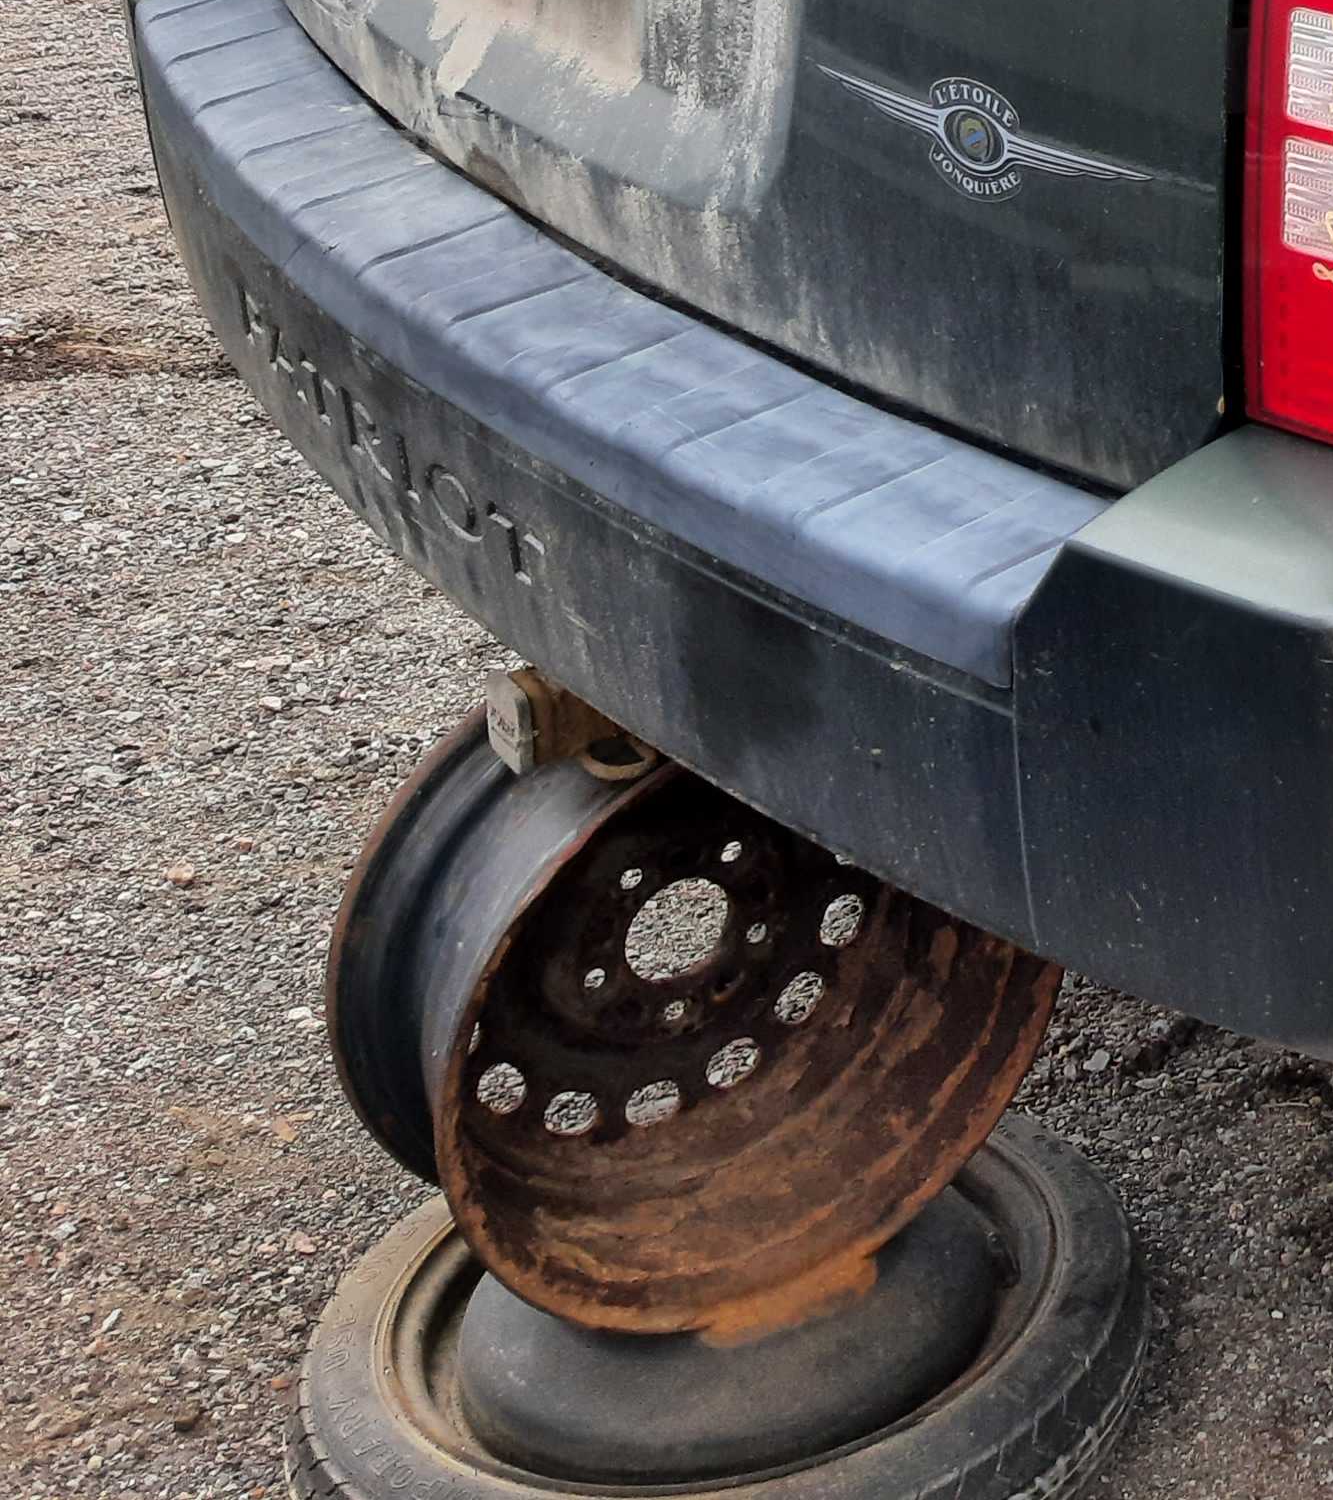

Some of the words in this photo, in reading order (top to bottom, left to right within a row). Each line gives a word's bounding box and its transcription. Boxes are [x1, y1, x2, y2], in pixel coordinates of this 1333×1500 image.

[937, 79, 1016, 128] L'ÉTOILE
[932, 150, 1021, 197] JONQUIÈRE
[236, 279, 548, 587] PATRIOT
